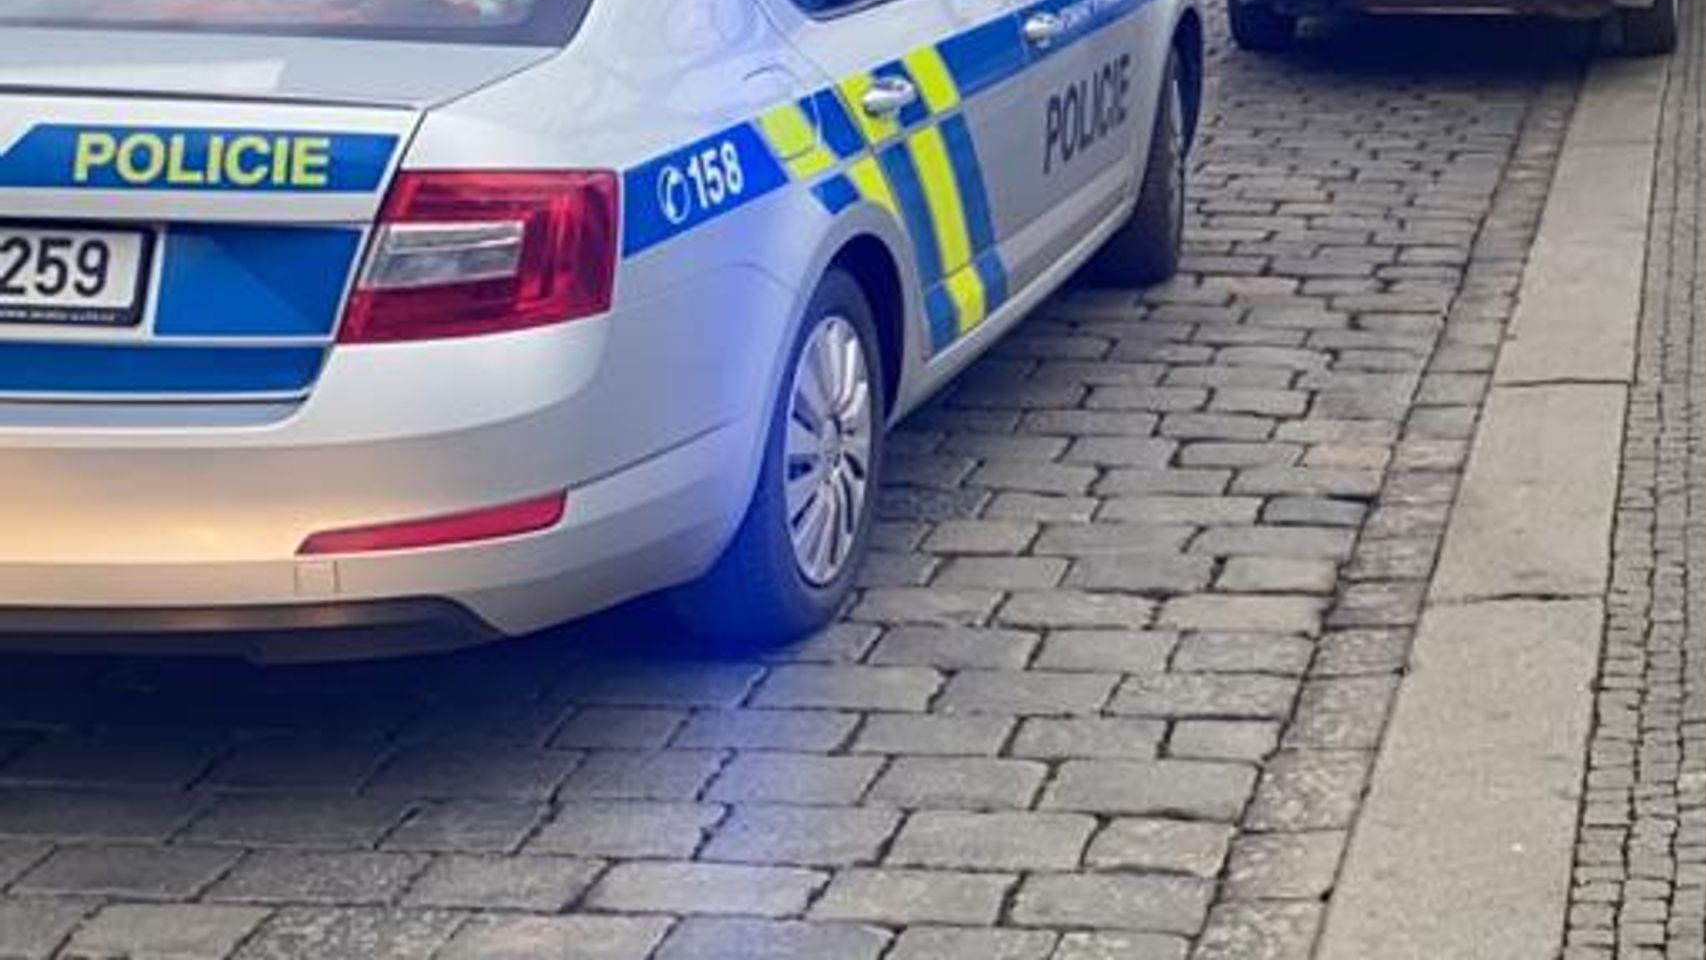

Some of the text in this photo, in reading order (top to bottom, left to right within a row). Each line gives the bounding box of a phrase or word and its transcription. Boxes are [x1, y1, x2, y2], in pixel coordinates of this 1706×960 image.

[1043, 52, 1131, 175] POLICIE
[73, 132, 330, 186] POLICIE
[688, 141, 744, 209] 158
[0, 236, 110, 298] 259
